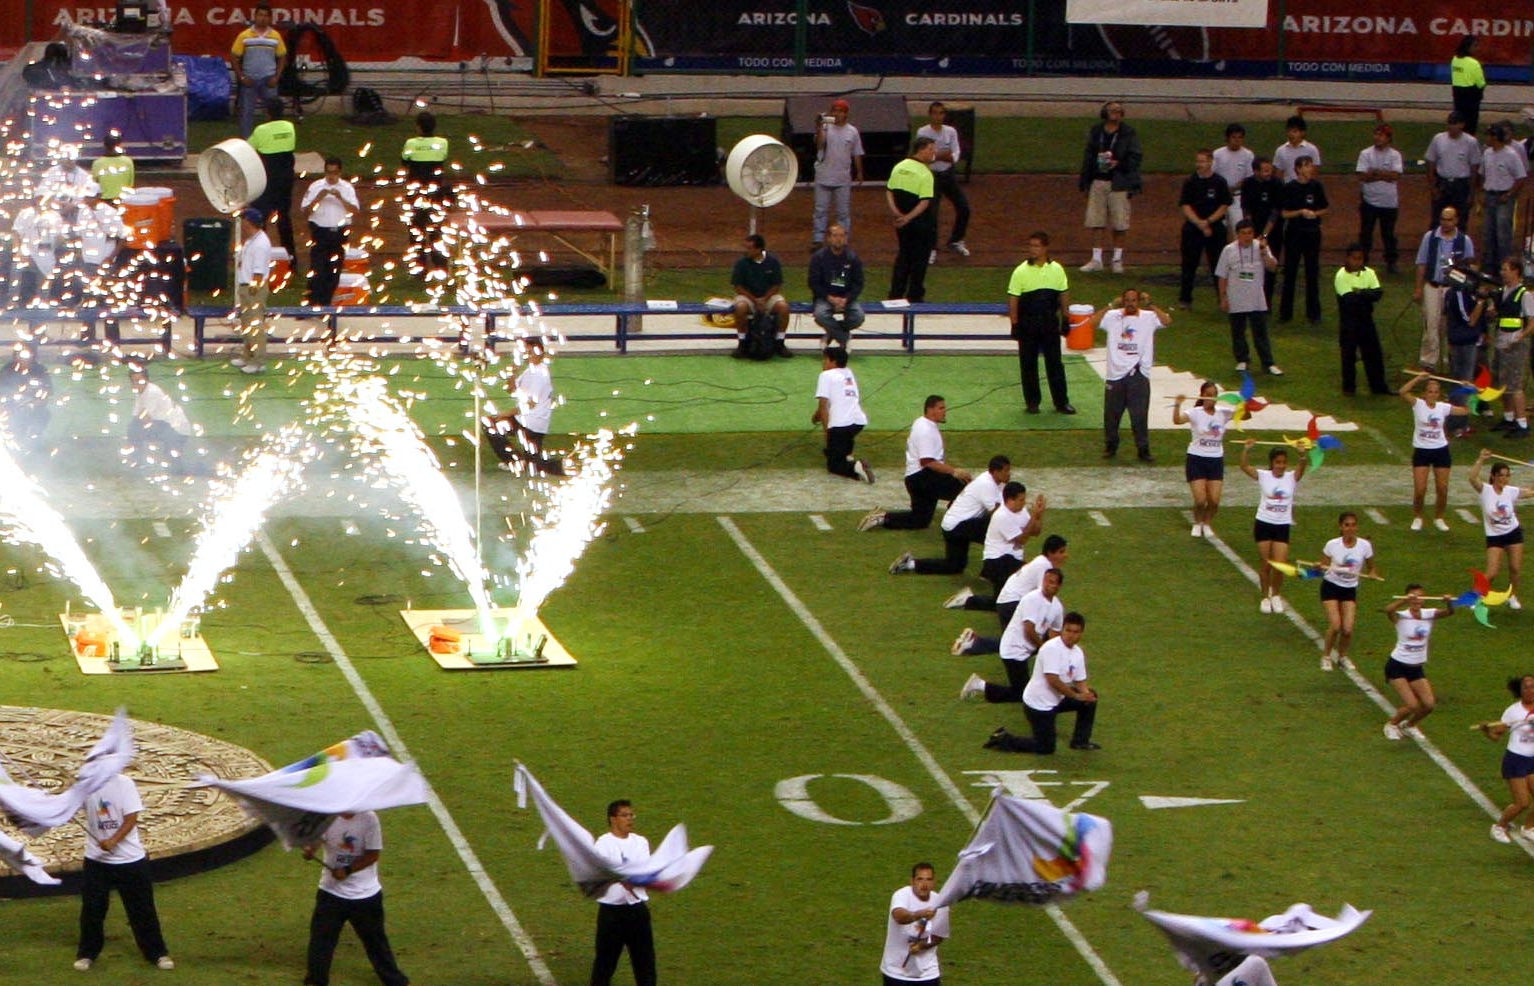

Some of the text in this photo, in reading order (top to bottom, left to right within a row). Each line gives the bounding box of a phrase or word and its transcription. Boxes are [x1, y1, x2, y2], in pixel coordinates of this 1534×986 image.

[206, 7, 385, 26] CADINALS
[906, 13, 1023, 25] CARDINALS
[1282, 16, 1418, 34] ARIZONA
[739, 57, 769, 67] TODO
[772, 57, 795, 67] CON
[1288, 62, 1391, 73] TODO CON MEDIDA
